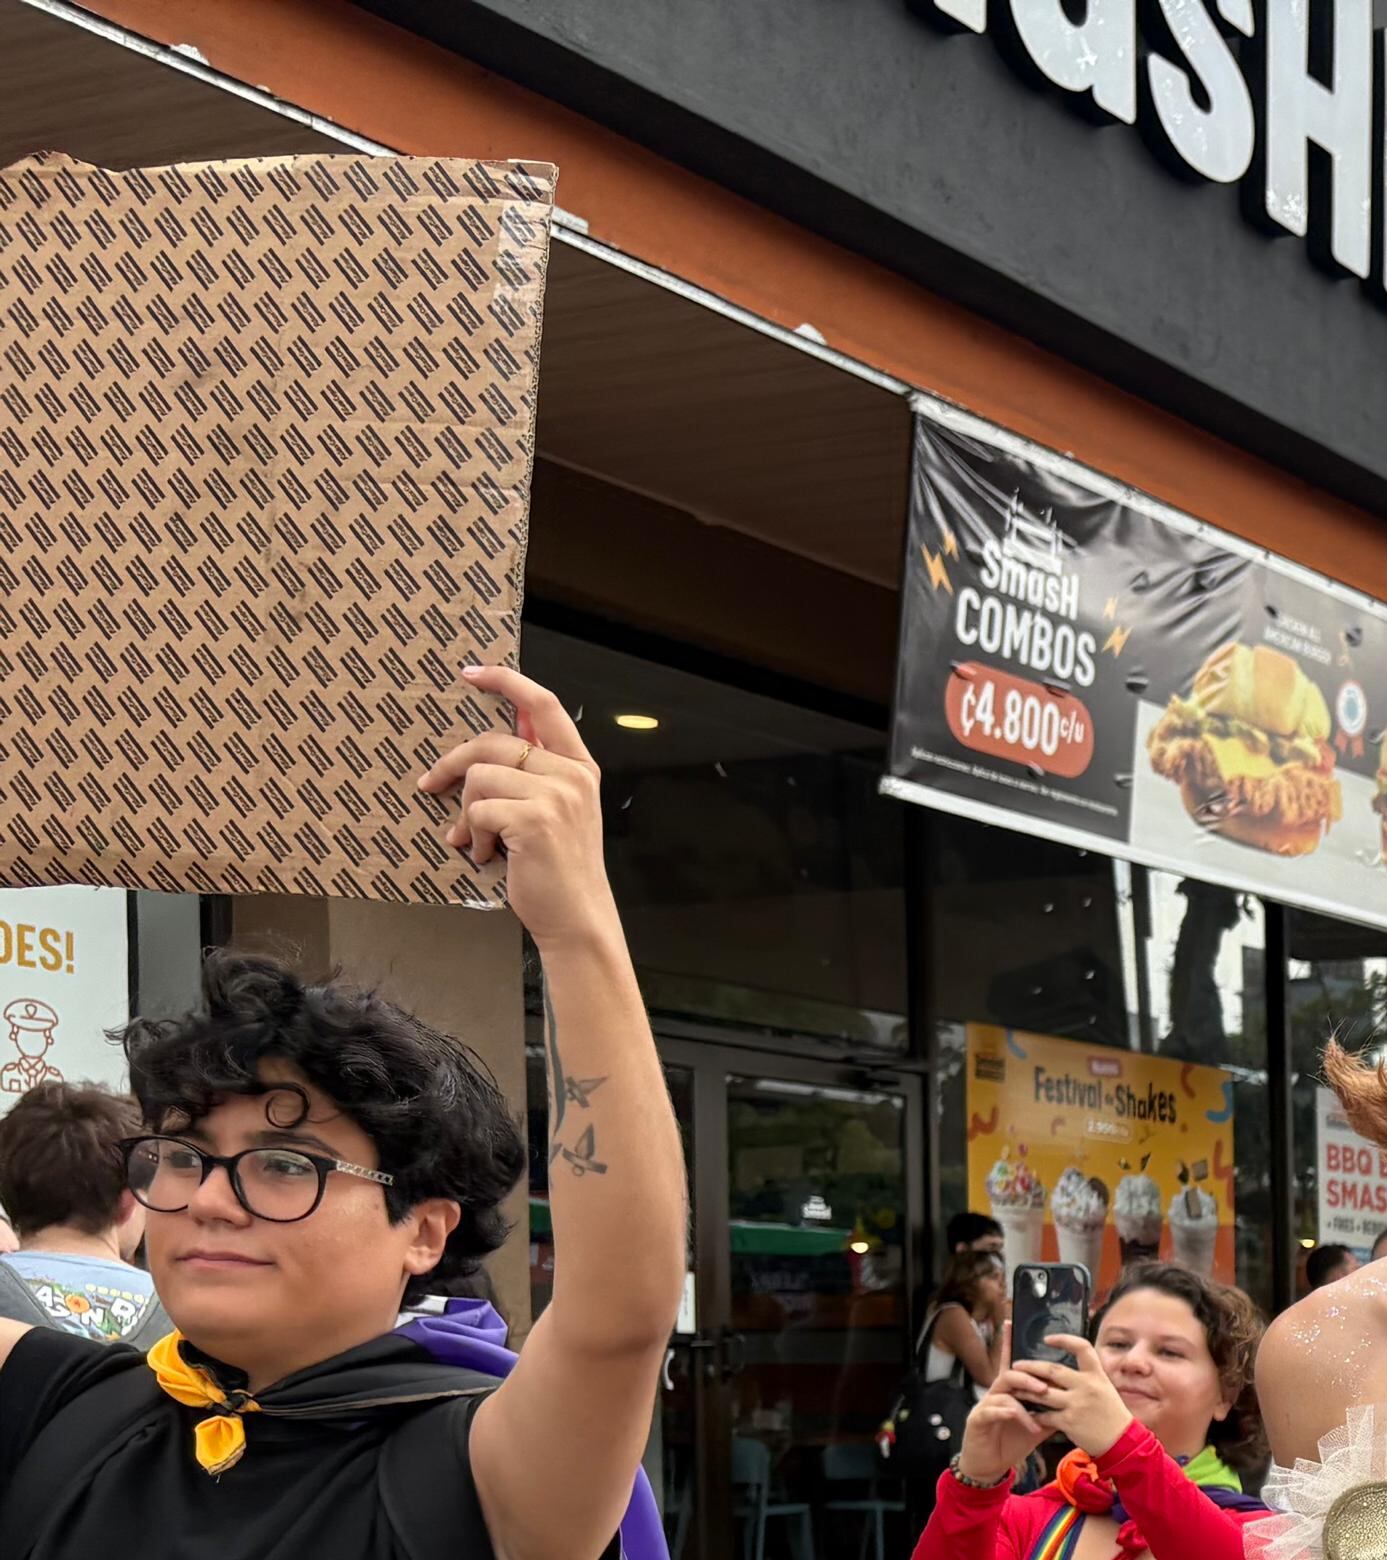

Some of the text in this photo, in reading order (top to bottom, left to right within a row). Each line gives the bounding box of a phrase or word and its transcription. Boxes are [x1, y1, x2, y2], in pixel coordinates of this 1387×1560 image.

[956, 587, 1096, 687] COMBOS
[1034, 1066, 1102, 1111] Festival
[1114, 1081, 1177, 1124] Shakes
[1326, 1143, 1373, 1176] BBQ
